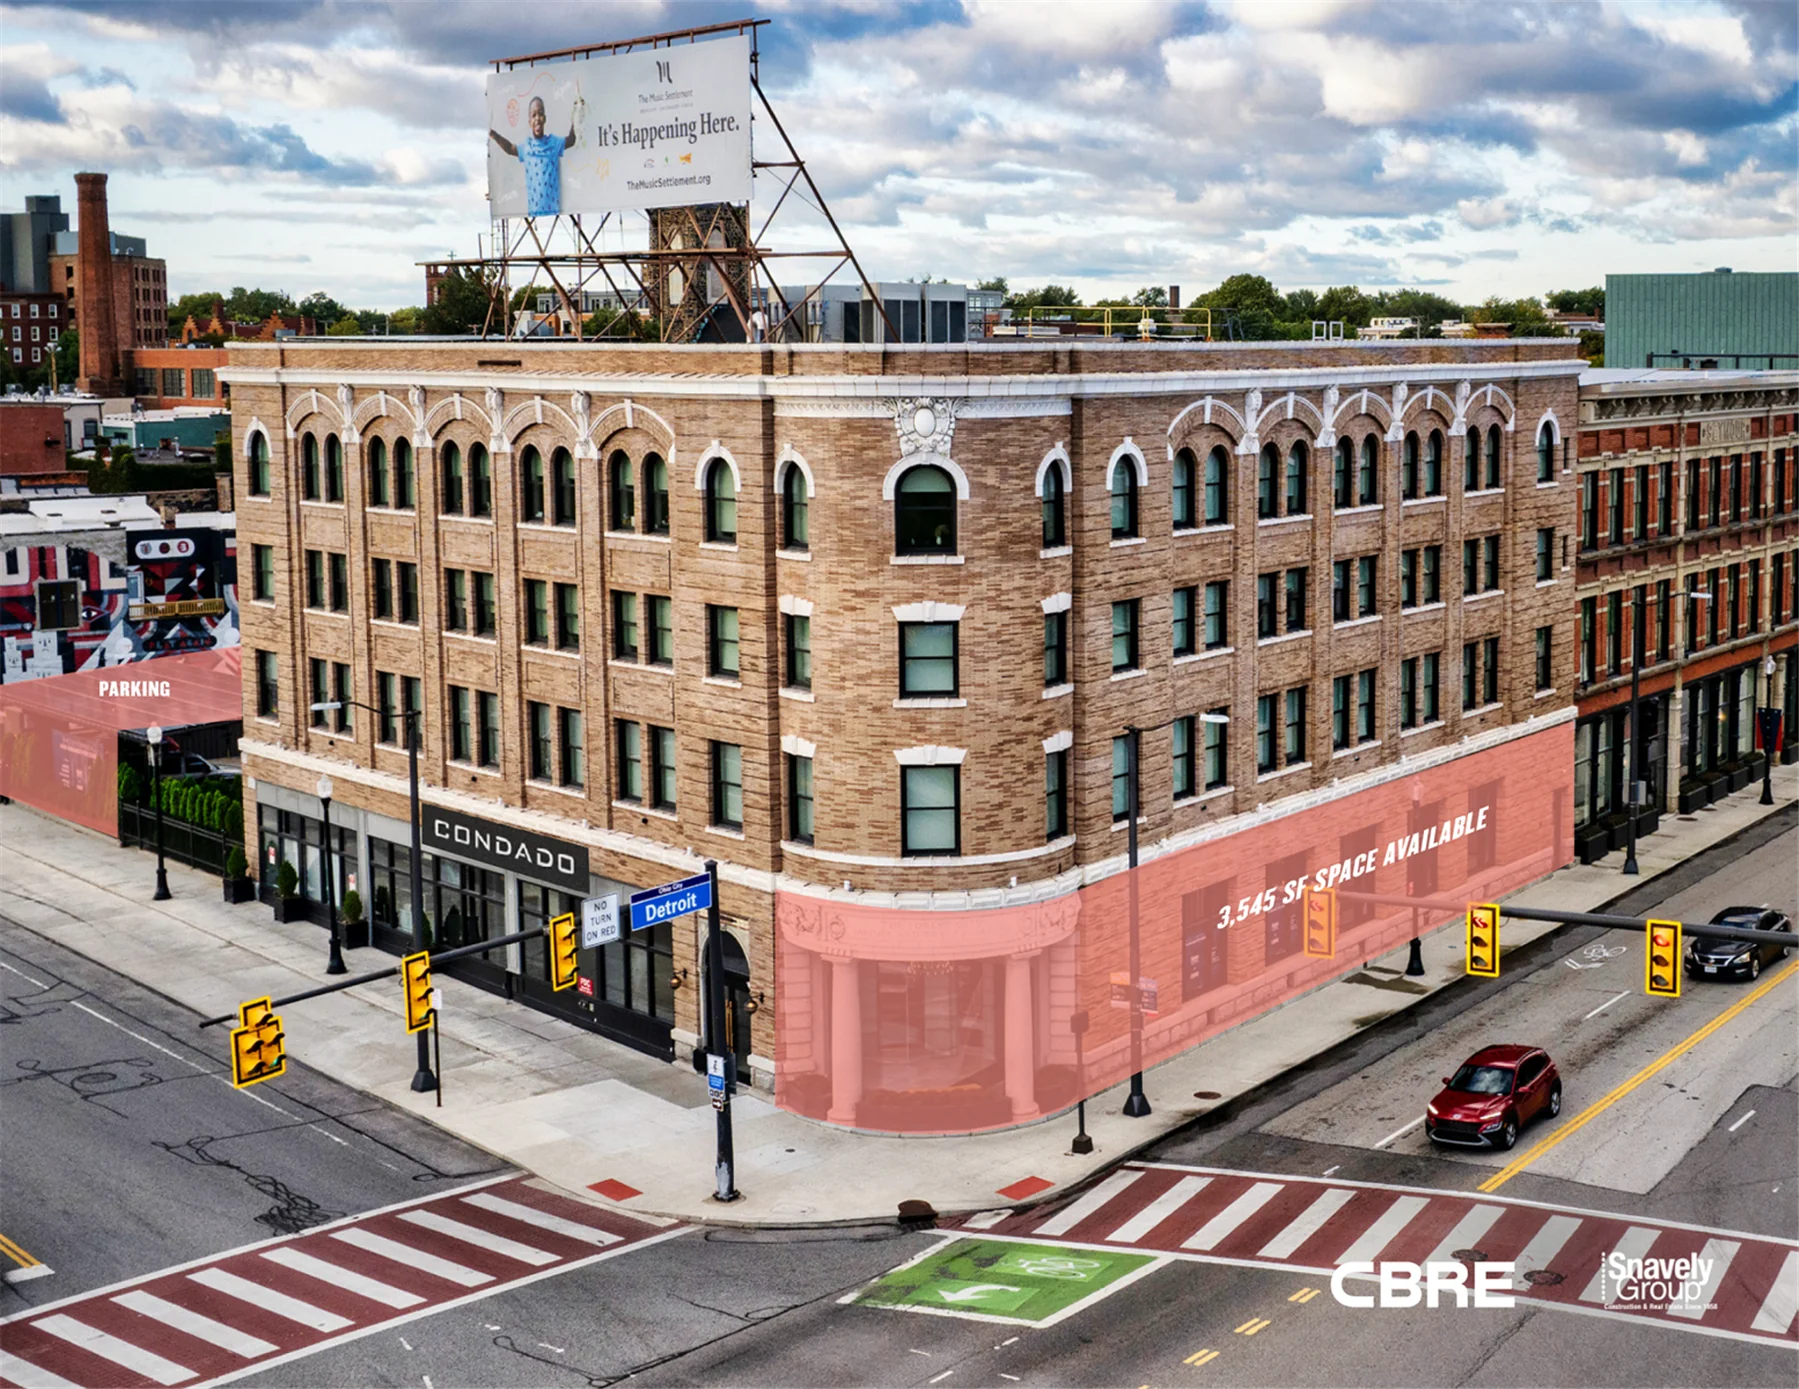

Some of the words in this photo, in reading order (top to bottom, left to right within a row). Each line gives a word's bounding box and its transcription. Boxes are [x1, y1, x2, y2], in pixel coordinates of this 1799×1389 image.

[598, 123, 619, 147] It's
[621, 116, 697, 149] Happening
[700, 112, 740, 135] Here.
[627, 175, 711, 191] TheMusicSettlement.org
[434, 819, 575, 874] CONDADO
[672, 883, 683, 892] City
[594, 901, 608, 912] NO
[645, 893, 697, 921] Detroit
[590, 913, 612, 926] TURN
[586, 930, 598, 941] ON
[601, 925, 616, 937] RED
